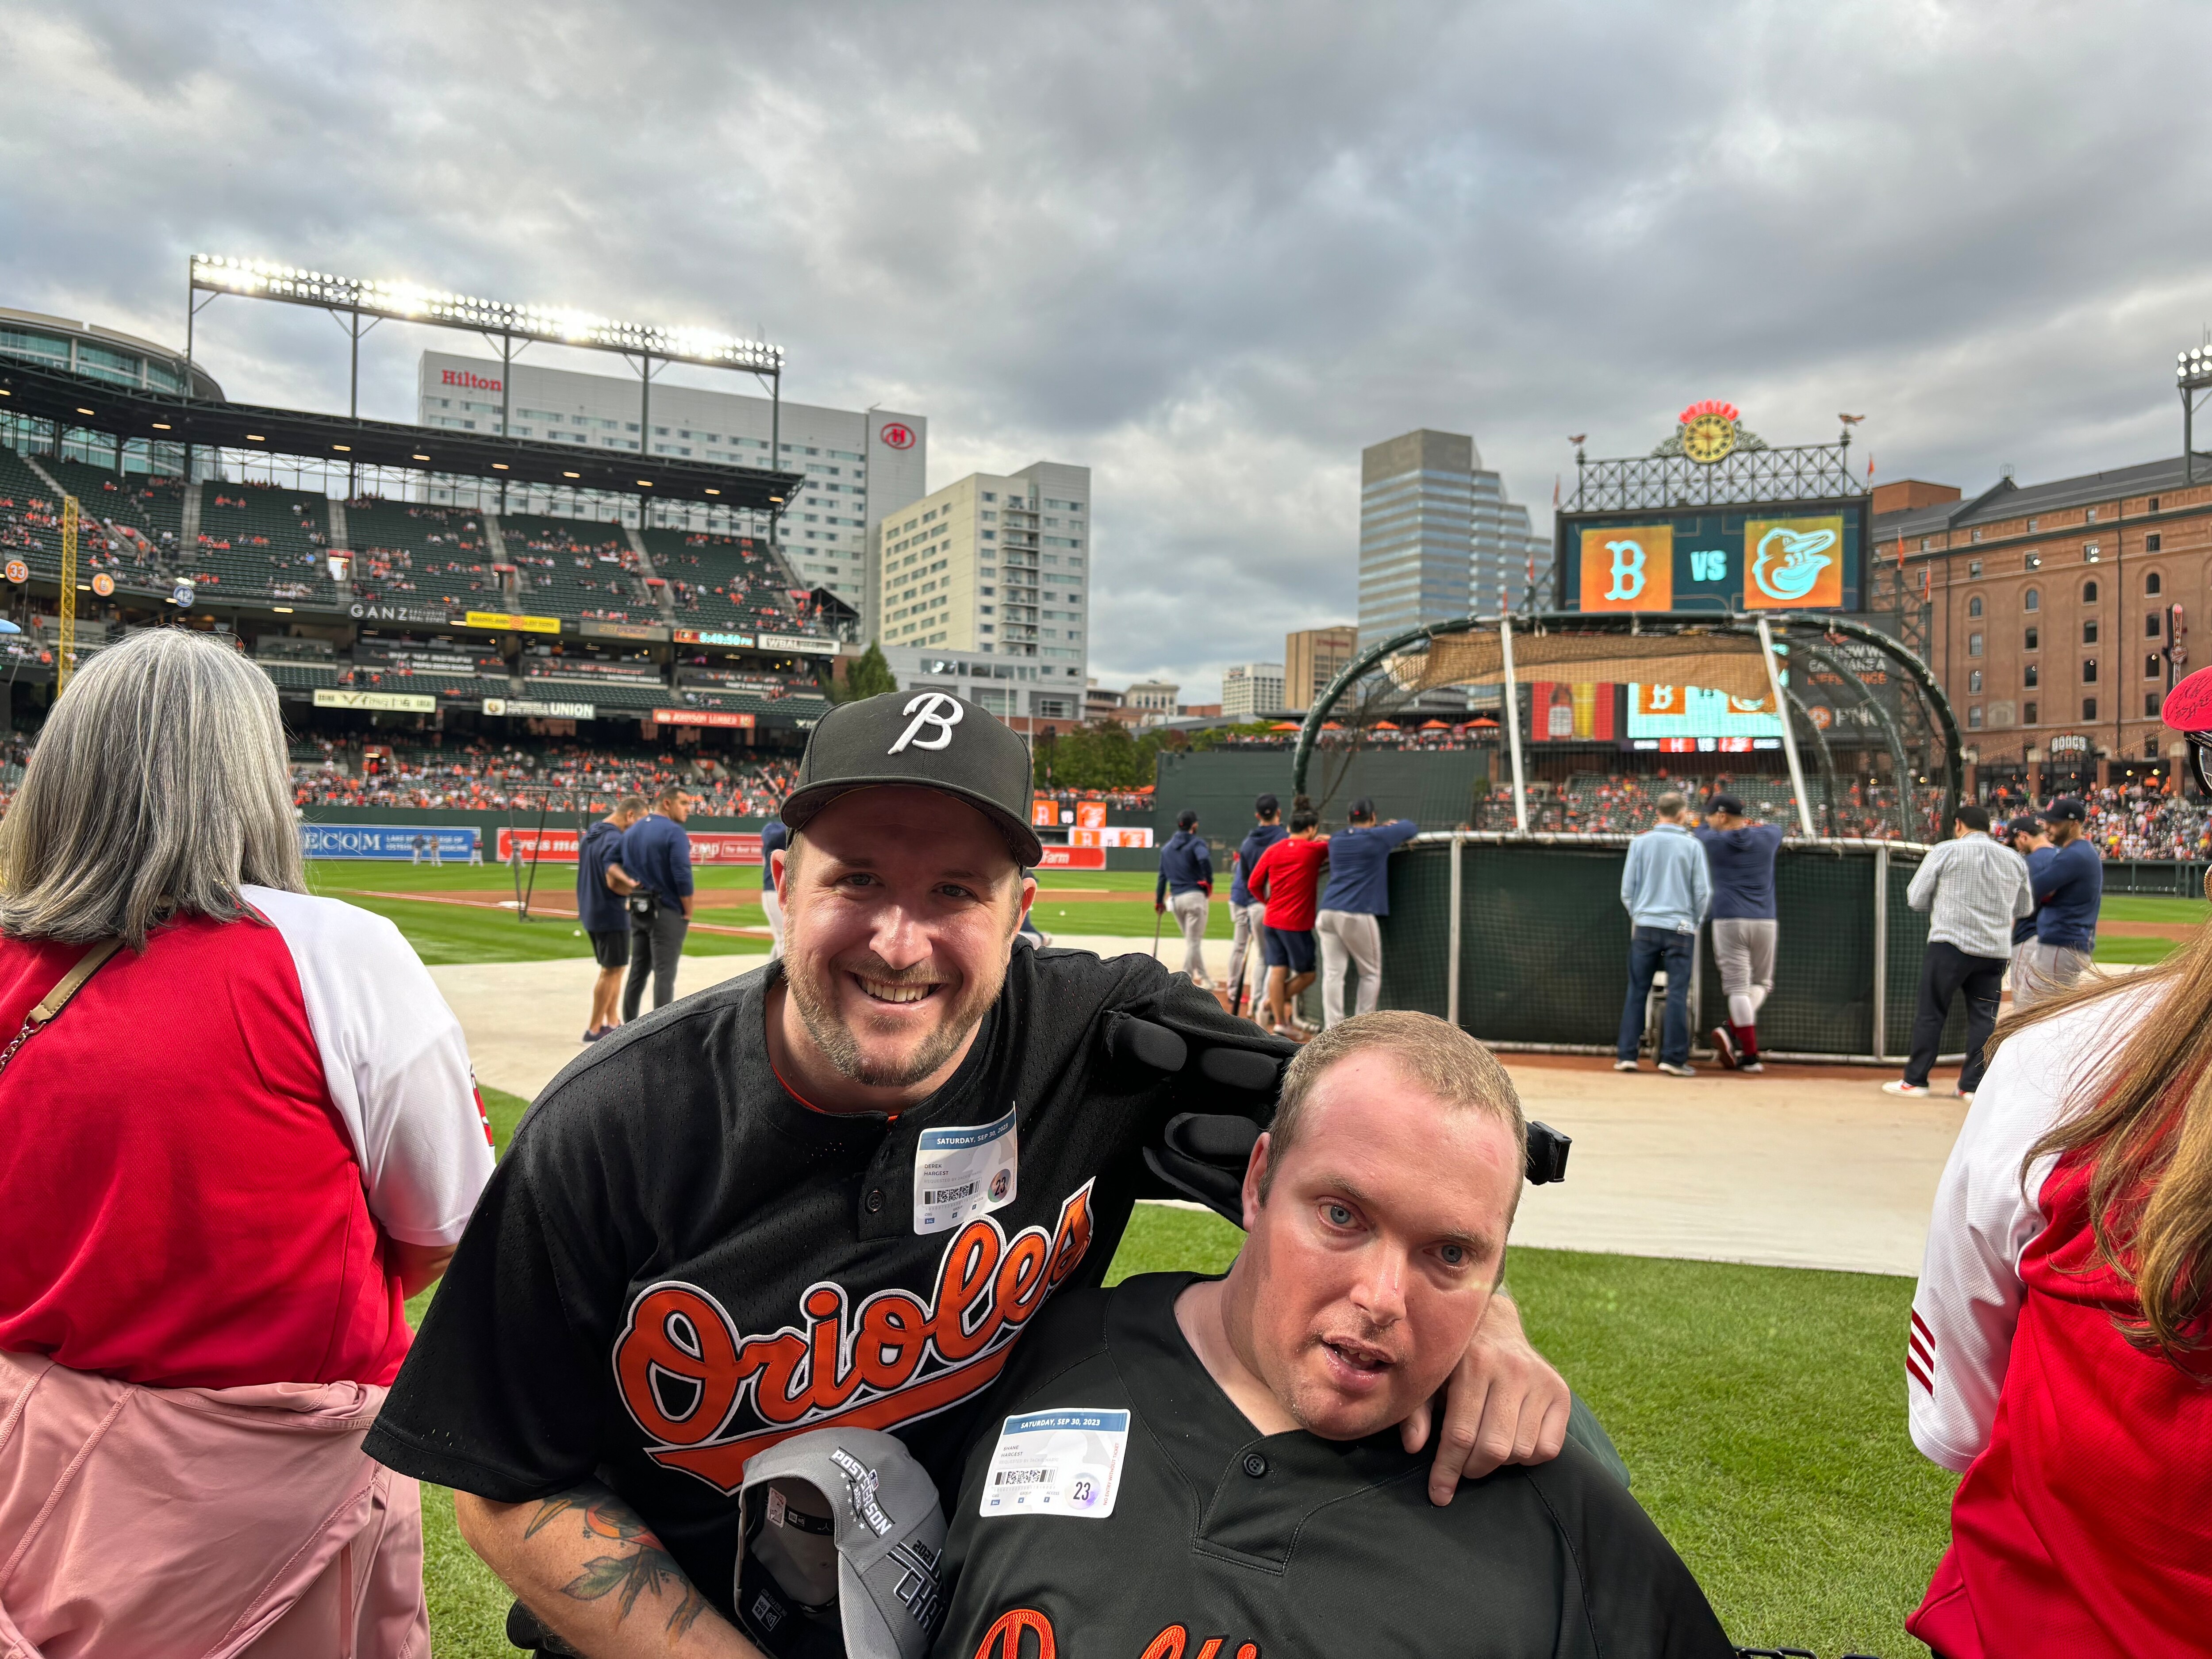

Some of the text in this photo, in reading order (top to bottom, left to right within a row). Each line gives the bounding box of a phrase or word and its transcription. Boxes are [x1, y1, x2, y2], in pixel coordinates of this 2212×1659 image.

[442, 369, 502, 392] Hilton
[9, 565, 25, 578] 33
[1605, 540, 1646, 600] B
[1690, 550, 1727, 581] VS
[177, 590, 191, 601] 42
[351, 604, 407, 620] GANZ
[699, 632, 753, 646] 5:49:50 PM
[766, 638, 800, 649] WBAL
[550, 702, 594, 717] UNION
[888, 693, 964, 755] B
[998, 1123, 1008, 1133] 2023
[994, 1176, 1006, 1197] 23
[612, 1176, 1096, 1446] Orioles
[1021, 1419, 1055, 1429] SATURDAY,
[831, 1450, 892, 1535] POSTSEASON
[1073, 1481, 1091, 1501] 23
[755, 1605, 764, 1617] NEW
[758, 1600, 767, 1611] ERA
